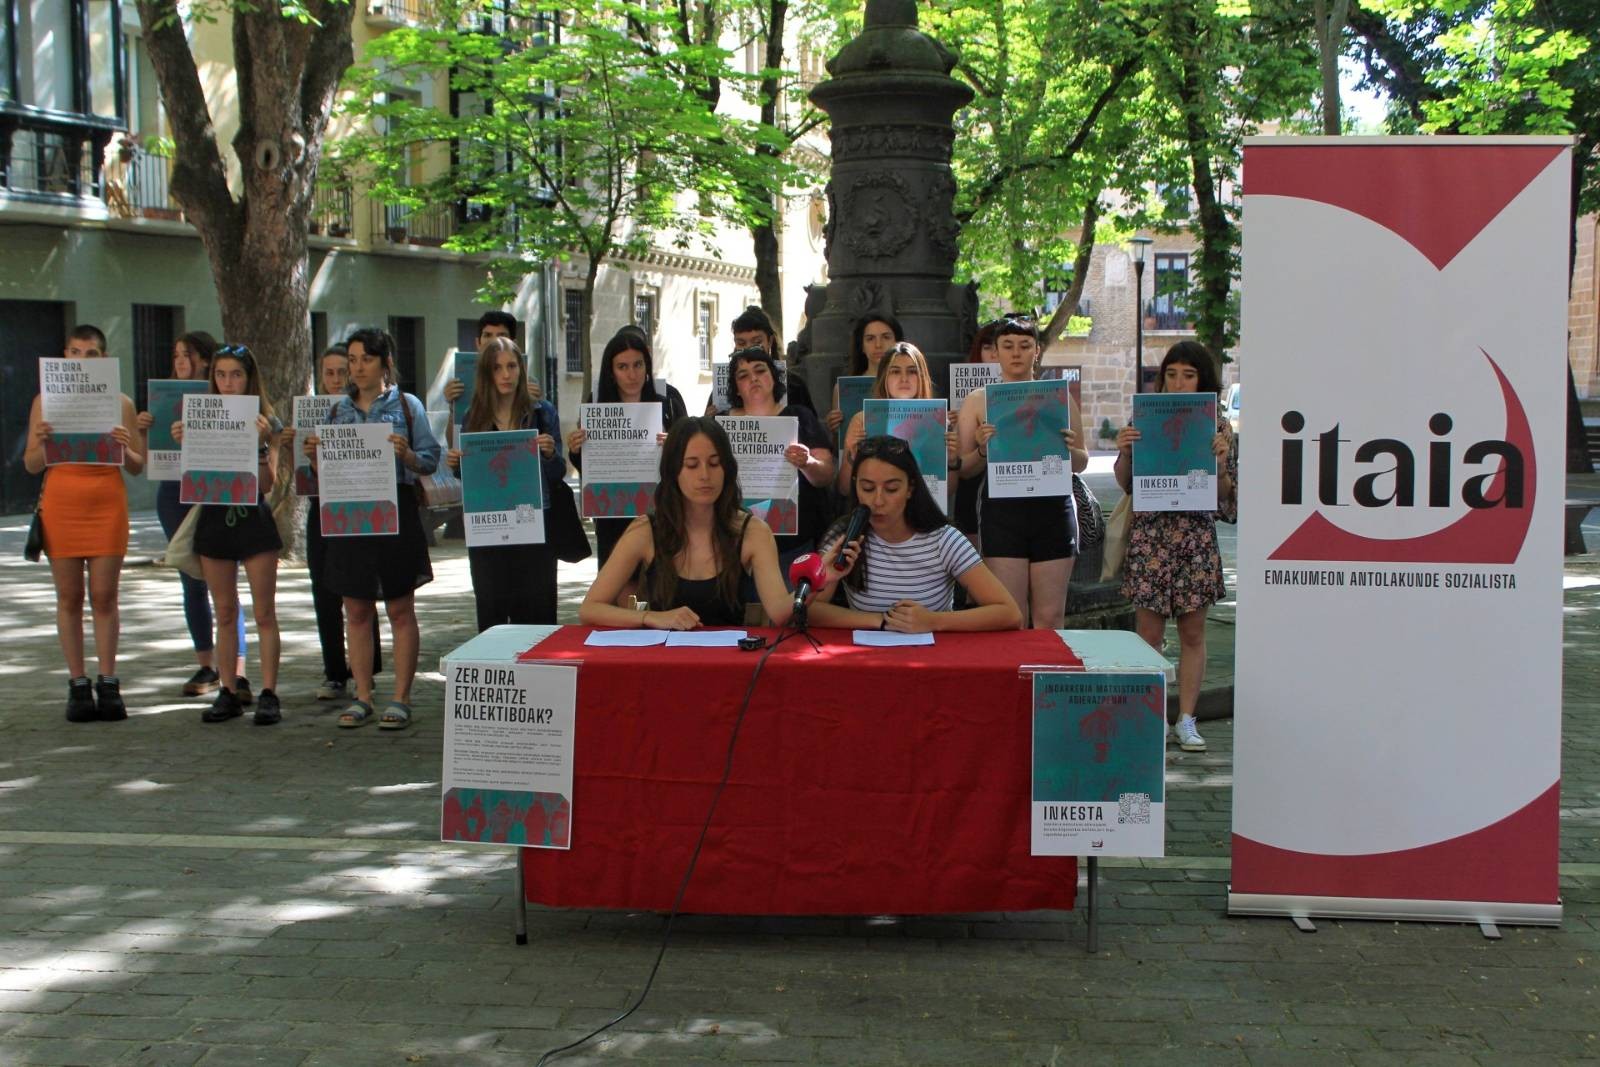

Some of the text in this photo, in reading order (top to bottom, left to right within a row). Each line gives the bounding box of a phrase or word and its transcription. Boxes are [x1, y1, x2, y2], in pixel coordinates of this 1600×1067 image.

[45, 362, 82, 372] ZER DIRA
[955, 367, 990, 377] ZER DIRA
[45, 373, 89, 383] ETXERATZE
[46, 383, 108, 394] KOLEKTIBOAK?
[187, 398, 223, 408] ZER DIRA
[298, 398, 331, 408] ZER DIRA
[187, 409, 230, 420] ETXERATZE
[586, 407, 625, 418] ZER DIRA
[187, 420, 246, 431] KOLEKTIBOAK?
[586, 418, 632, 429] ETXERATZE
[740, 420, 760, 431] DIRA
[321, 429, 335, 439] ZER
[338, 428, 358, 438] DIRA
[586, 429, 649, 441] KOLEKTIBOAK?
[321, 438, 365, 450] ETXERATZE
[322, 449, 382, 461] KOLEKTIBOAK?
[1281, 410, 1525, 510] itaia
[995, 464, 1034, 476] INKESTA
[1140, 478, 1179, 489] INKESTA
[471, 513, 508, 525] INKESTA
[1264, 569, 1516, 590] EMAKUMEON ANTOLAKUNDE SOZIALISTA
[455, 667, 516, 686] ZER DIRA
[455, 685, 527, 705] ETXERATZE
[454, 703, 553, 724] KOLEKTIBOAK?
[1043, 806, 1104, 821] INKESTA
